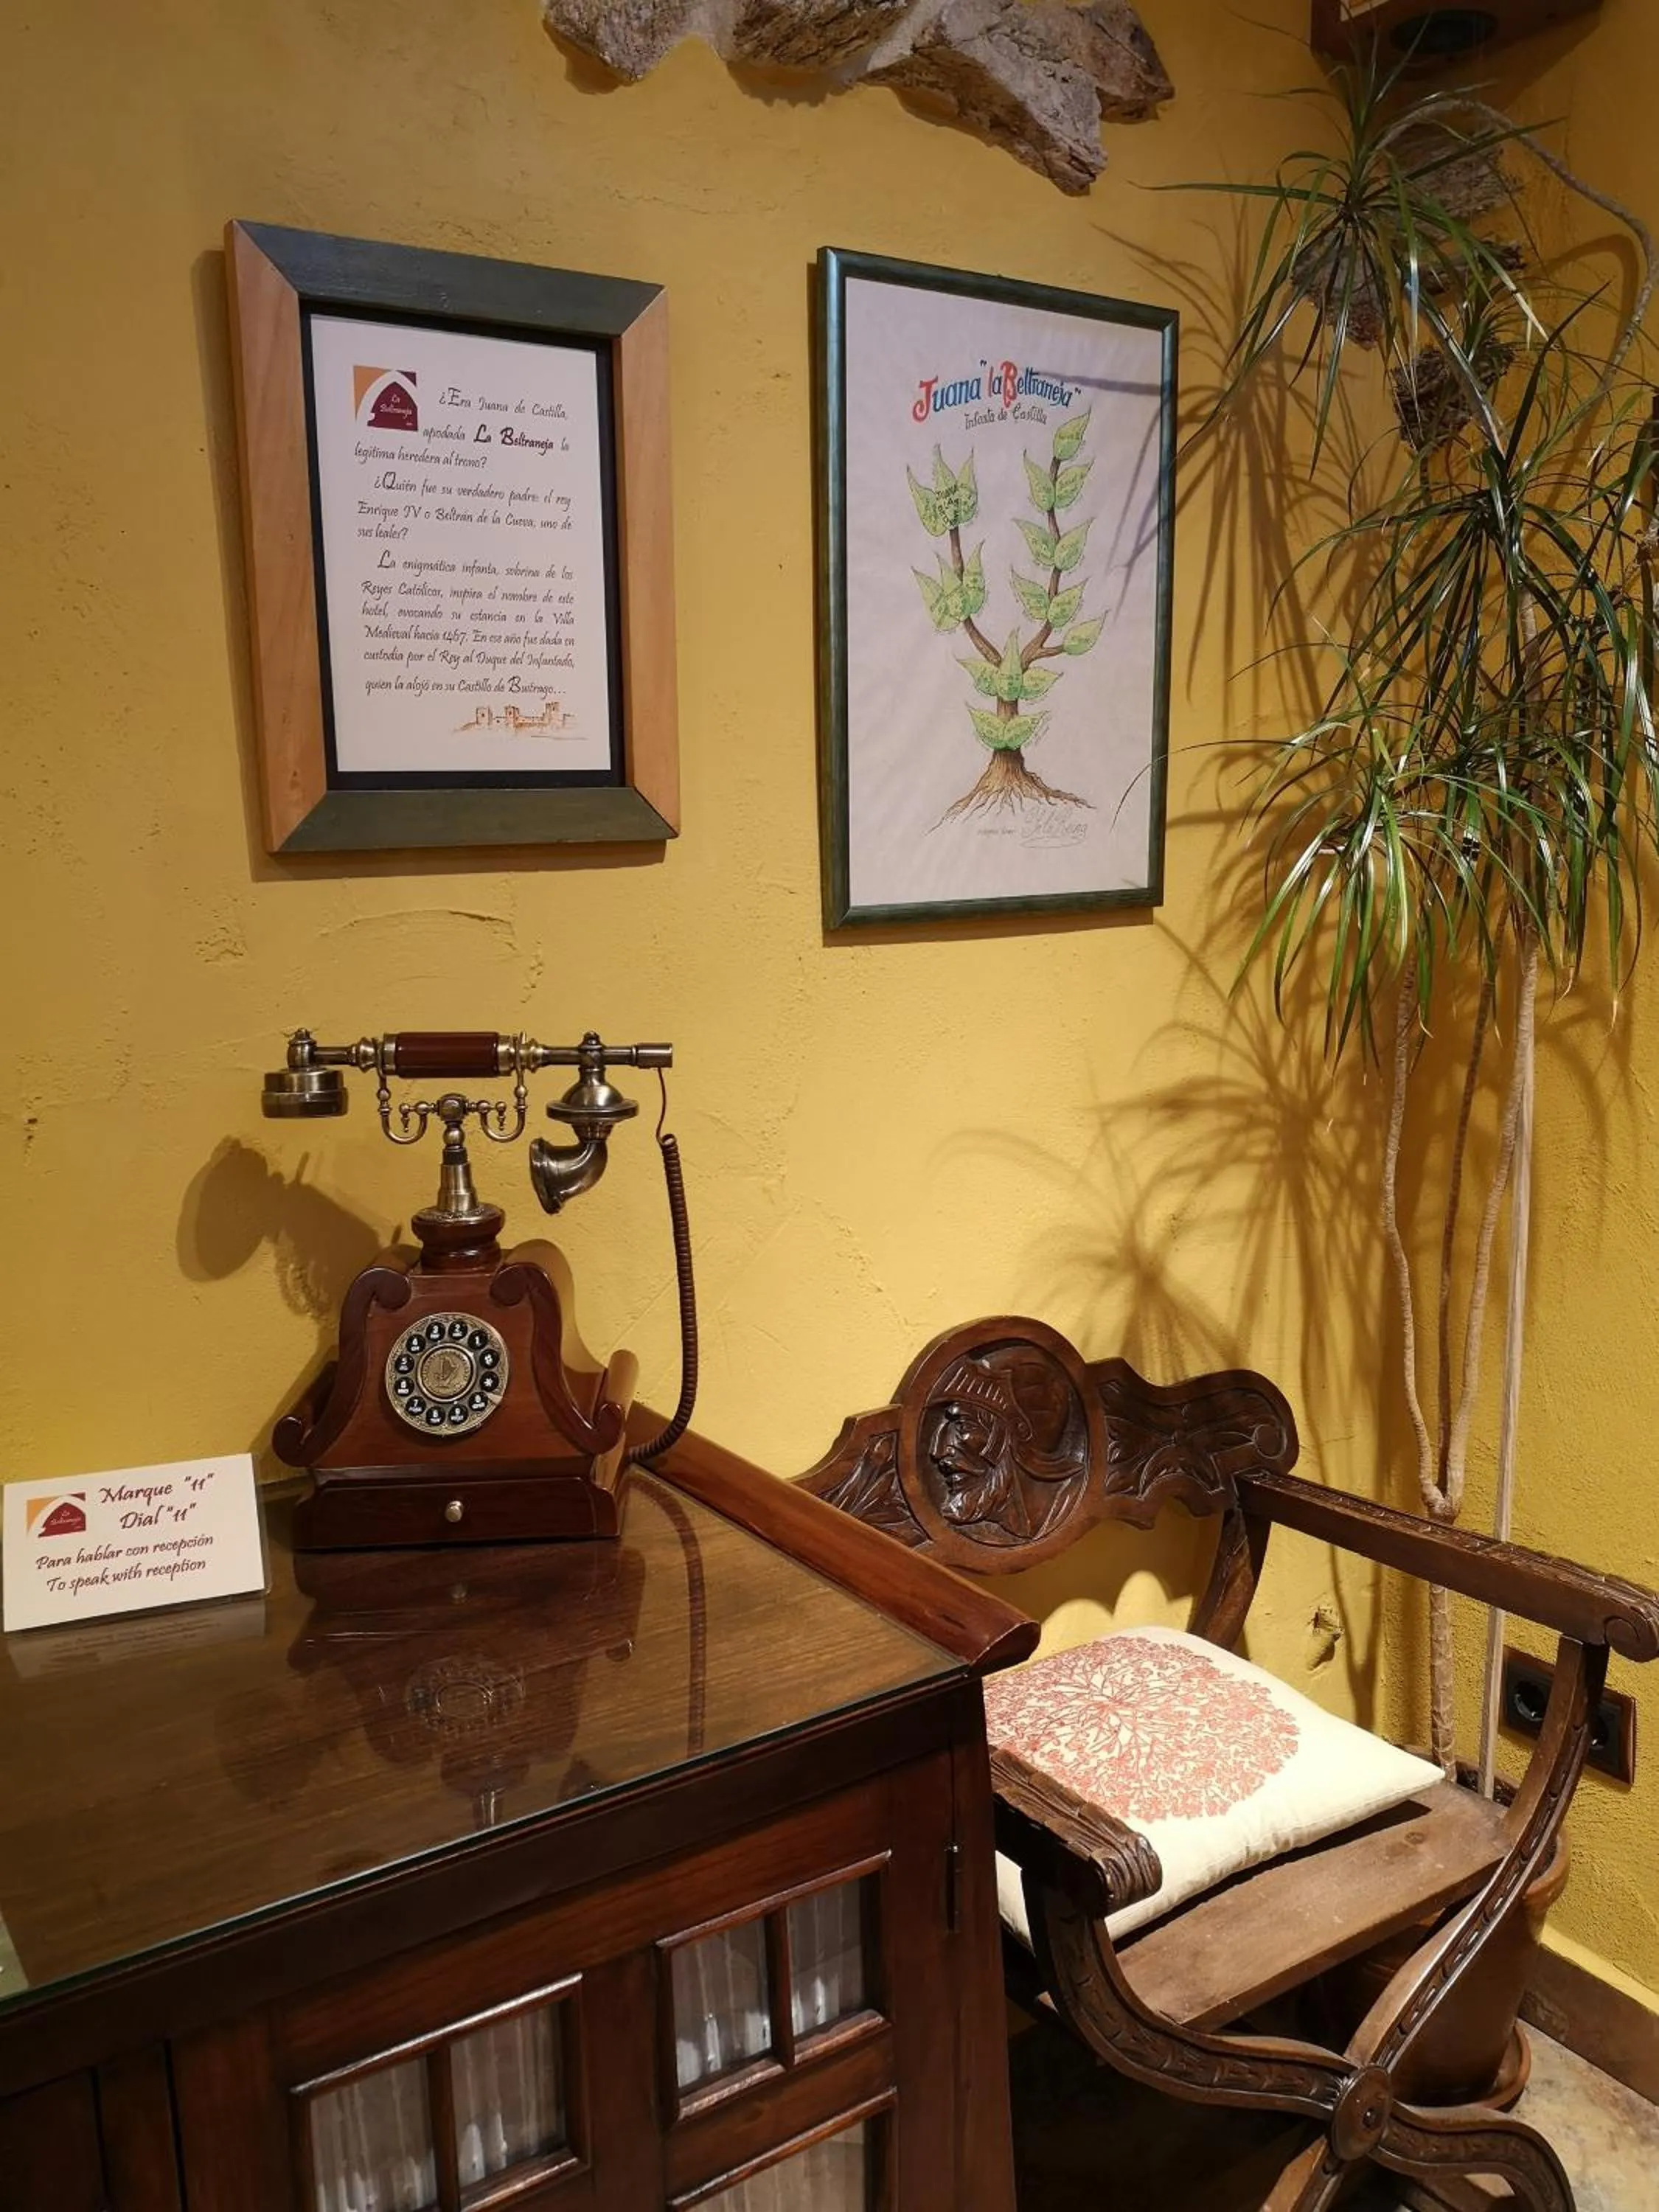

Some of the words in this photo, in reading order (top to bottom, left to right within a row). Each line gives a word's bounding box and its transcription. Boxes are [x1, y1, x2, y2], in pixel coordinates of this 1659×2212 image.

[439, 387, 471, 408] ¿Era
[479, 397, 508, 411] Juana
[514, 399, 526, 413] de
[912, 375, 981, 422] Juana
[998, 408, 1008, 422] de
[1012, 402, 1048, 425] Castilla
[422, 425, 465, 444] apodada
[473, 423, 492, 442] La
[500, 427, 554, 456] Beltraneja
[561, 437, 569, 451] la
[397, 445, 440, 464] heredera
[442, 451, 453, 466] al
[453, 453, 487, 468] trono?
[421, 478, 437, 496] fue
[440, 486, 453, 495] su
[457, 483, 504, 500] verdadero
[543, 489, 554, 504] el
[555, 496, 571, 512] rey
[358, 501, 399, 522] Enrique
[424, 511, 430, 519] o
[476, 508, 488, 523] de
[492, 509, 501, 524] la
[540, 520, 558, 529] uno
[561, 515, 572, 529] de
[357, 528, 374, 538] sus
[375, 523, 408, 540] leales?
[377, 549, 396, 568] La
[403, 559, 456, 577] enigmática
[505, 561, 540, 577] sobrina
[546, 564, 555, 578] de
[561, 566, 573, 580] los
[361, 580, 392, 600] Reyes
[449, 588, 483, 605] inspira
[487, 585, 498, 599] el
[501, 587, 538, 602] nombre
[543, 589, 553, 602] de
[558, 592, 574, 604] este
[362, 601, 389, 618] hotel,
[398, 604, 443, 619] evocando
[451, 611, 462, 620] su
[470, 608, 507, 622] estancia
[515, 613, 526, 622] en
[535, 609, 543, 623] la
[553, 611, 574, 625] Villa
[365, 624, 411, 639] Medieval
[413, 625, 439, 640] hacia
[473, 630, 487, 642] En
[489, 635, 502, 644] ese
[504, 633, 521, 644] año
[524, 631, 538, 647] fue
[539, 631, 563, 645] dada
[564, 638, 574, 647] en
[364, 645, 404, 661] custodia
[406, 651, 425, 669] por
[427, 648, 437, 661] el
[439, 650, 461, 669] Rey
[462, 648, 476, 664] al
[476, 651, 507, 670] Duque
[509, 651, 526, 665] del
[365, 680, 392, 696] quien
[394, 675, 404, 690] la
[431, 683, 443, 691] en
[458, 678, 492, 692] Castillo
[493, 678, 504, 692] de
[99, 1485, 173, 1506] Marque
[119, 1506, 165, 1529] Dial
[35, 1555, 72, 1570] Para
[76, 1544, 123, 1564] hablar
[125, 1545, 149, 1557] con
[153, 1533, 214, 1557] recepción
[46, 1578, 66, 1592] To
[69, 1567, 110, 1596] speak
[112, 1561, 143, 1582] with
[146, 1559, 206, 1581] reception
